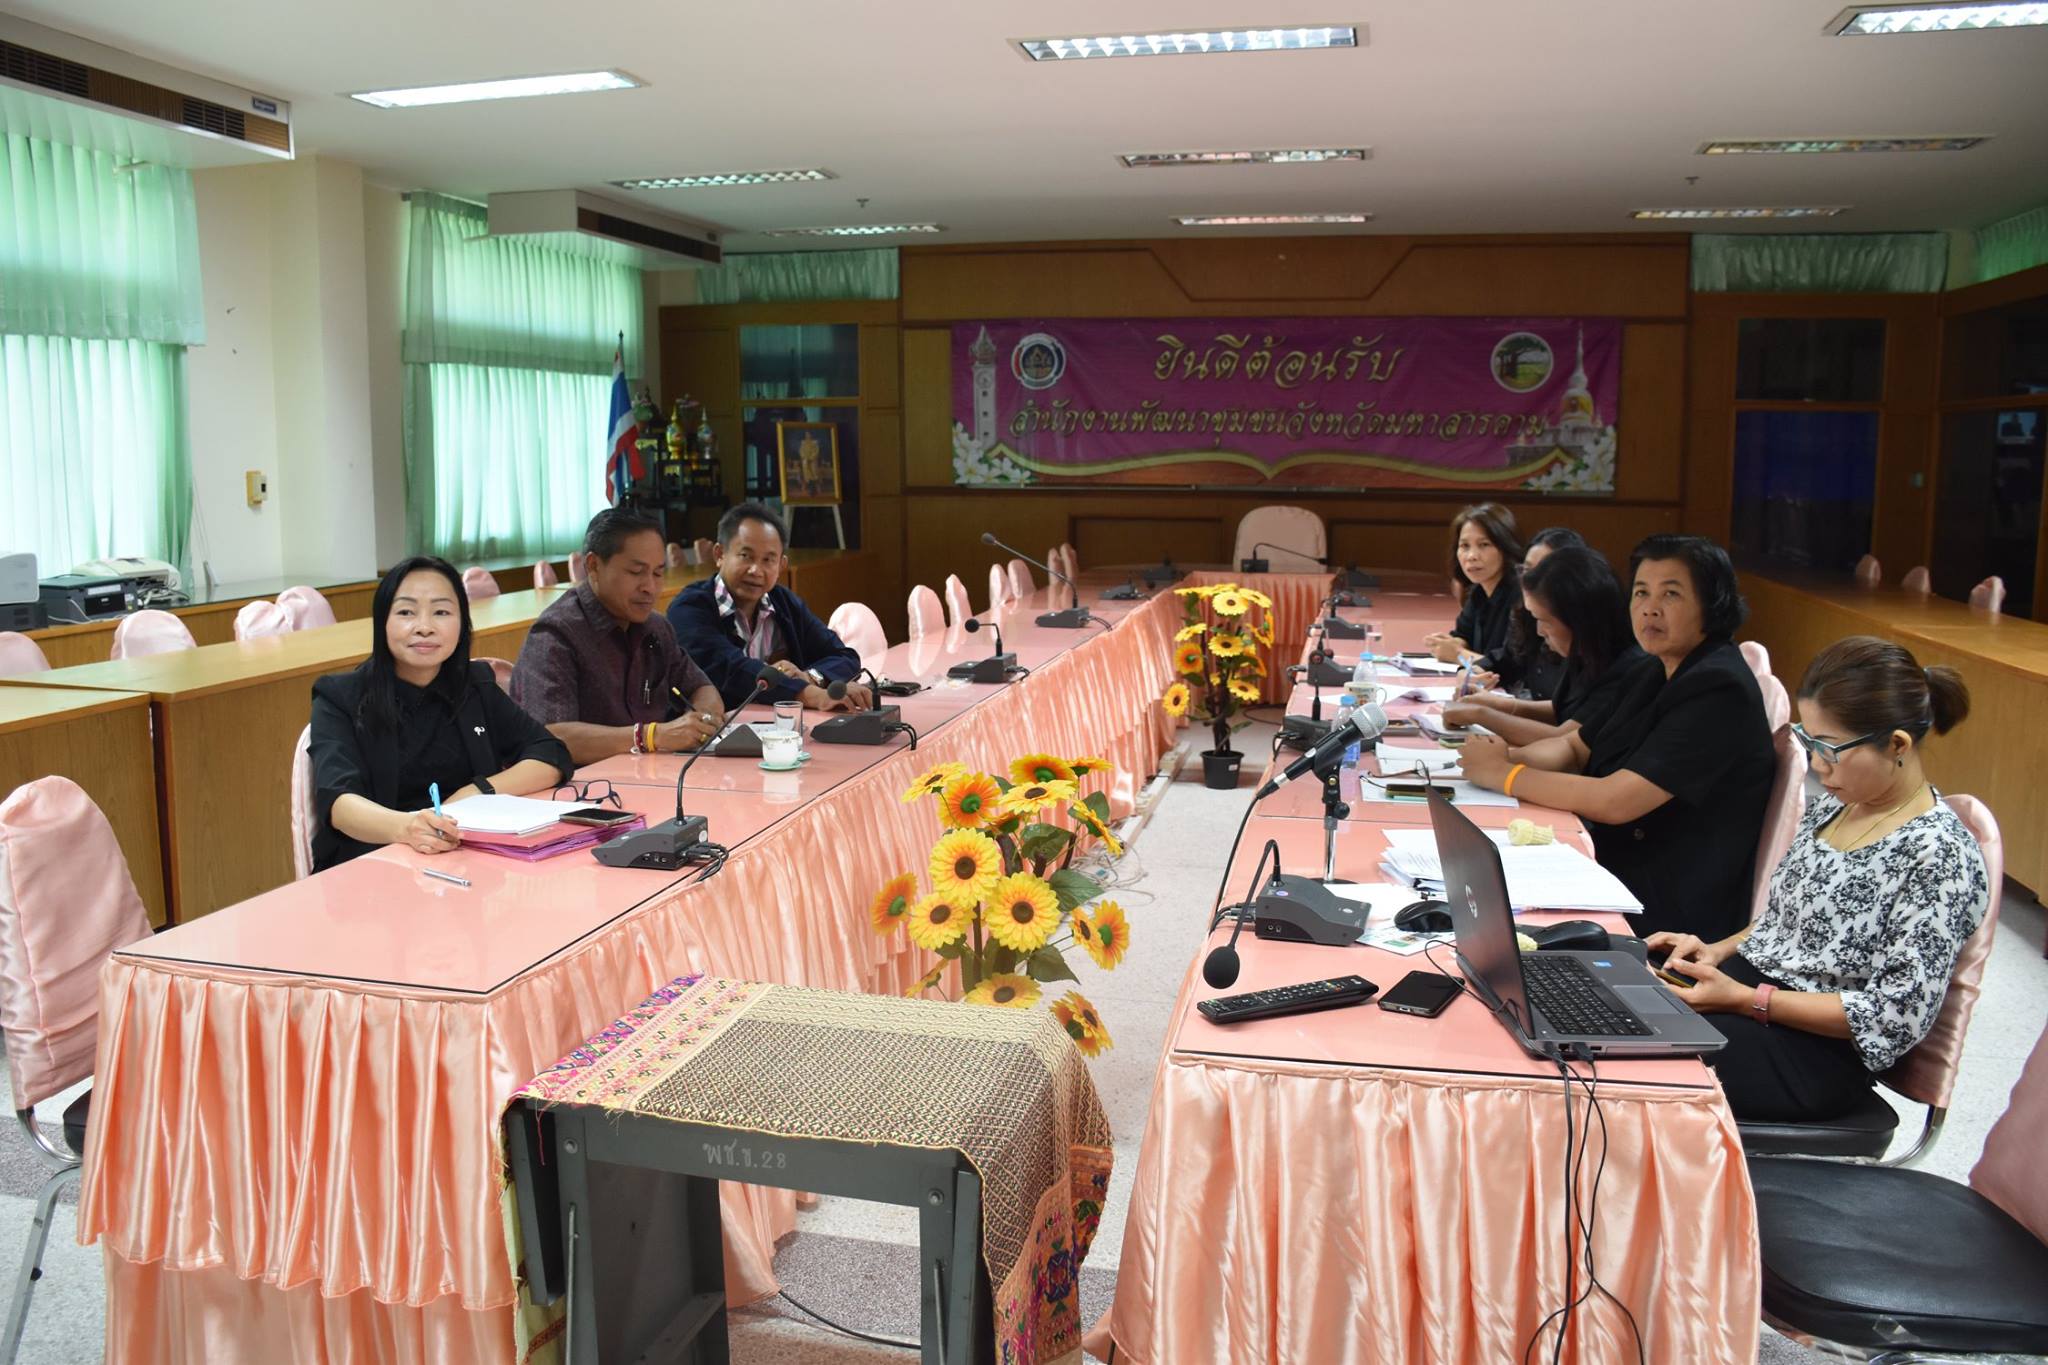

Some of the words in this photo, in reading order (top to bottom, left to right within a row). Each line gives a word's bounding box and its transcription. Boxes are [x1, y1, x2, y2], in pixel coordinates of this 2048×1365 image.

[1154, 333, 1404, 389] ยินดีต้อนรับ
[1009, 399, 1547, 447] สำนักงานพัฒนาชุมชนจังหวัดมหาสารคาม
